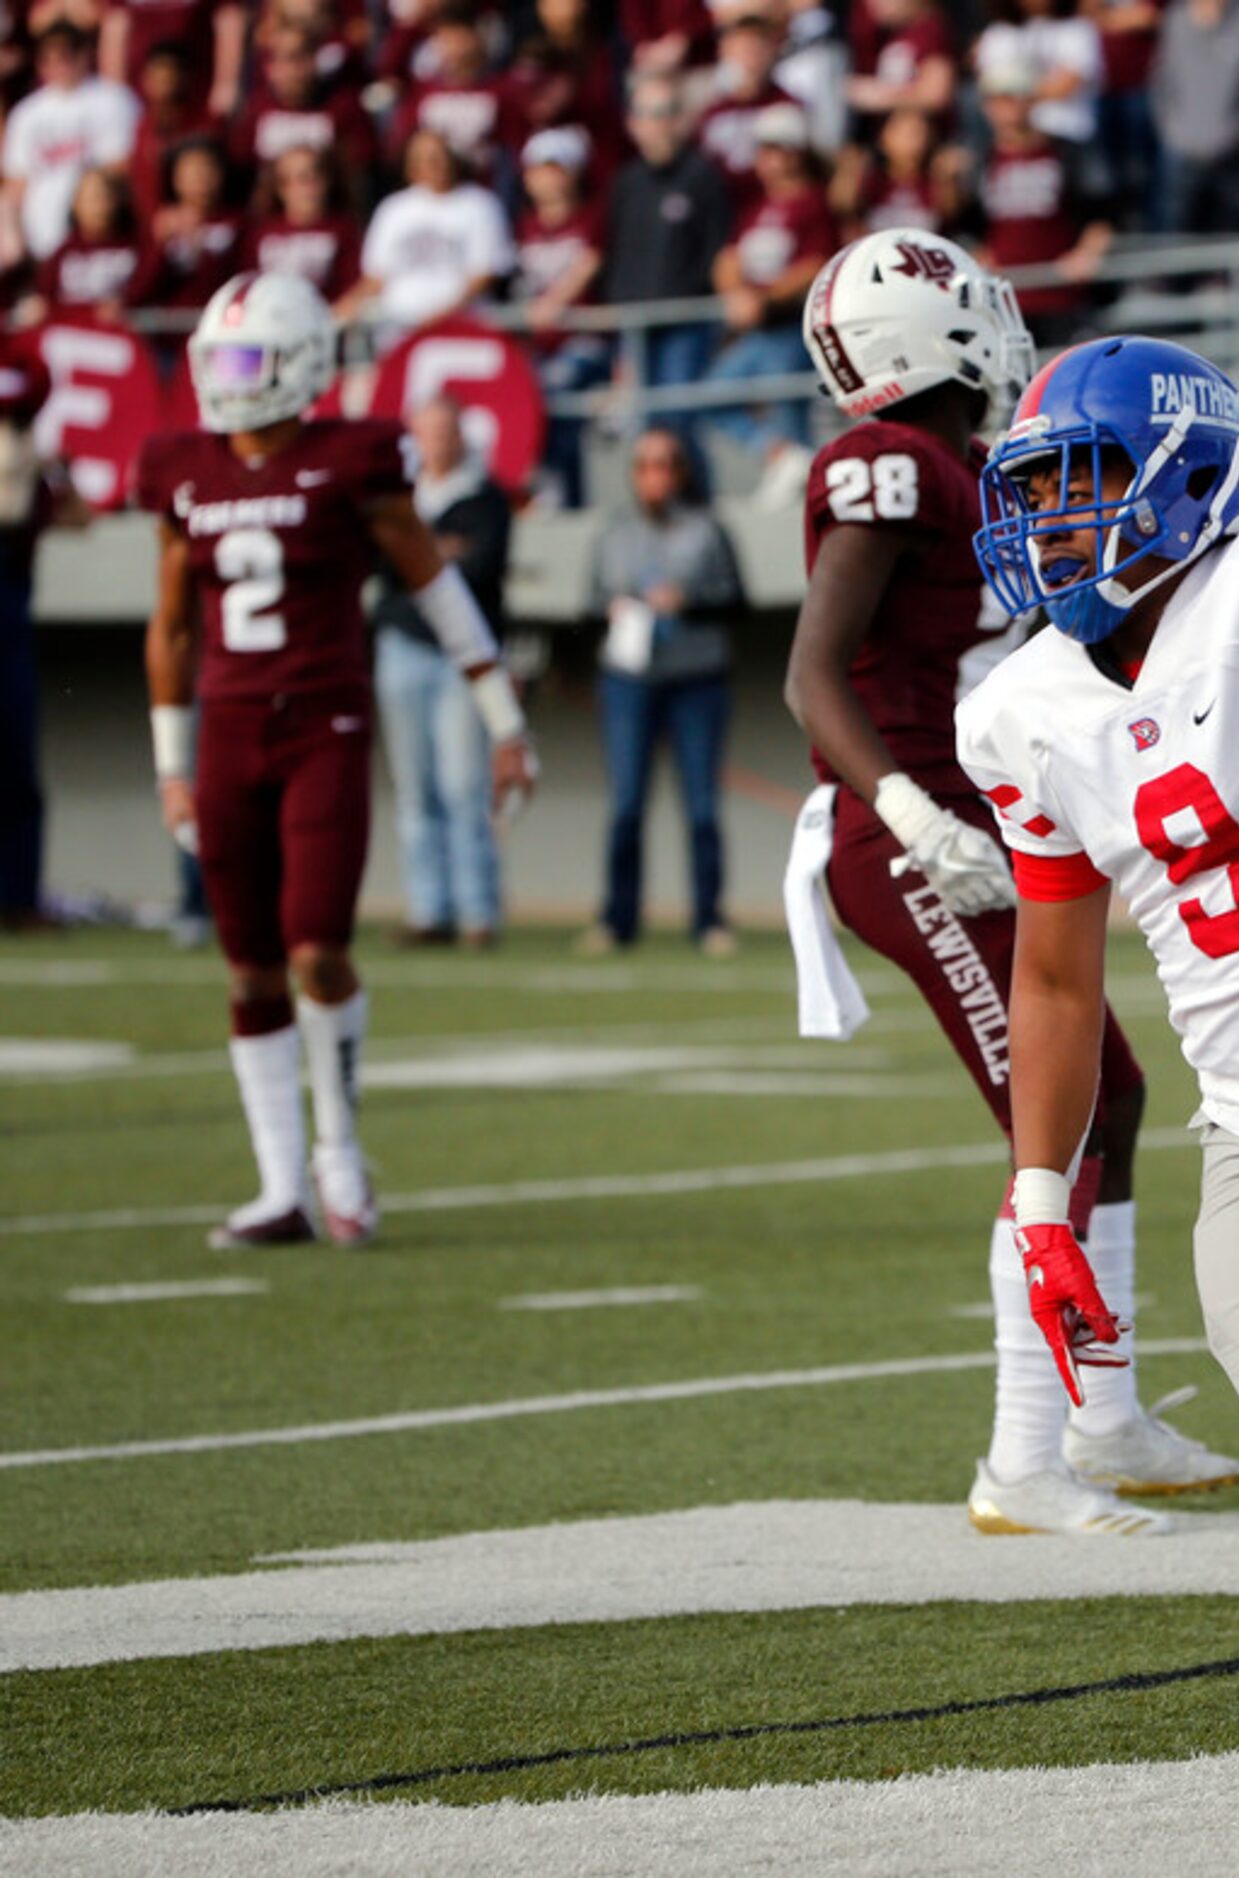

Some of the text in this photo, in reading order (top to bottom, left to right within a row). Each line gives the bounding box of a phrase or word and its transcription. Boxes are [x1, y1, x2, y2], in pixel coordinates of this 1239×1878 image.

[825, 453, 918, 522] 28
[214, 528, 287, 653] 2
[903, 885, 1011, 1086] LEWISVILLE
